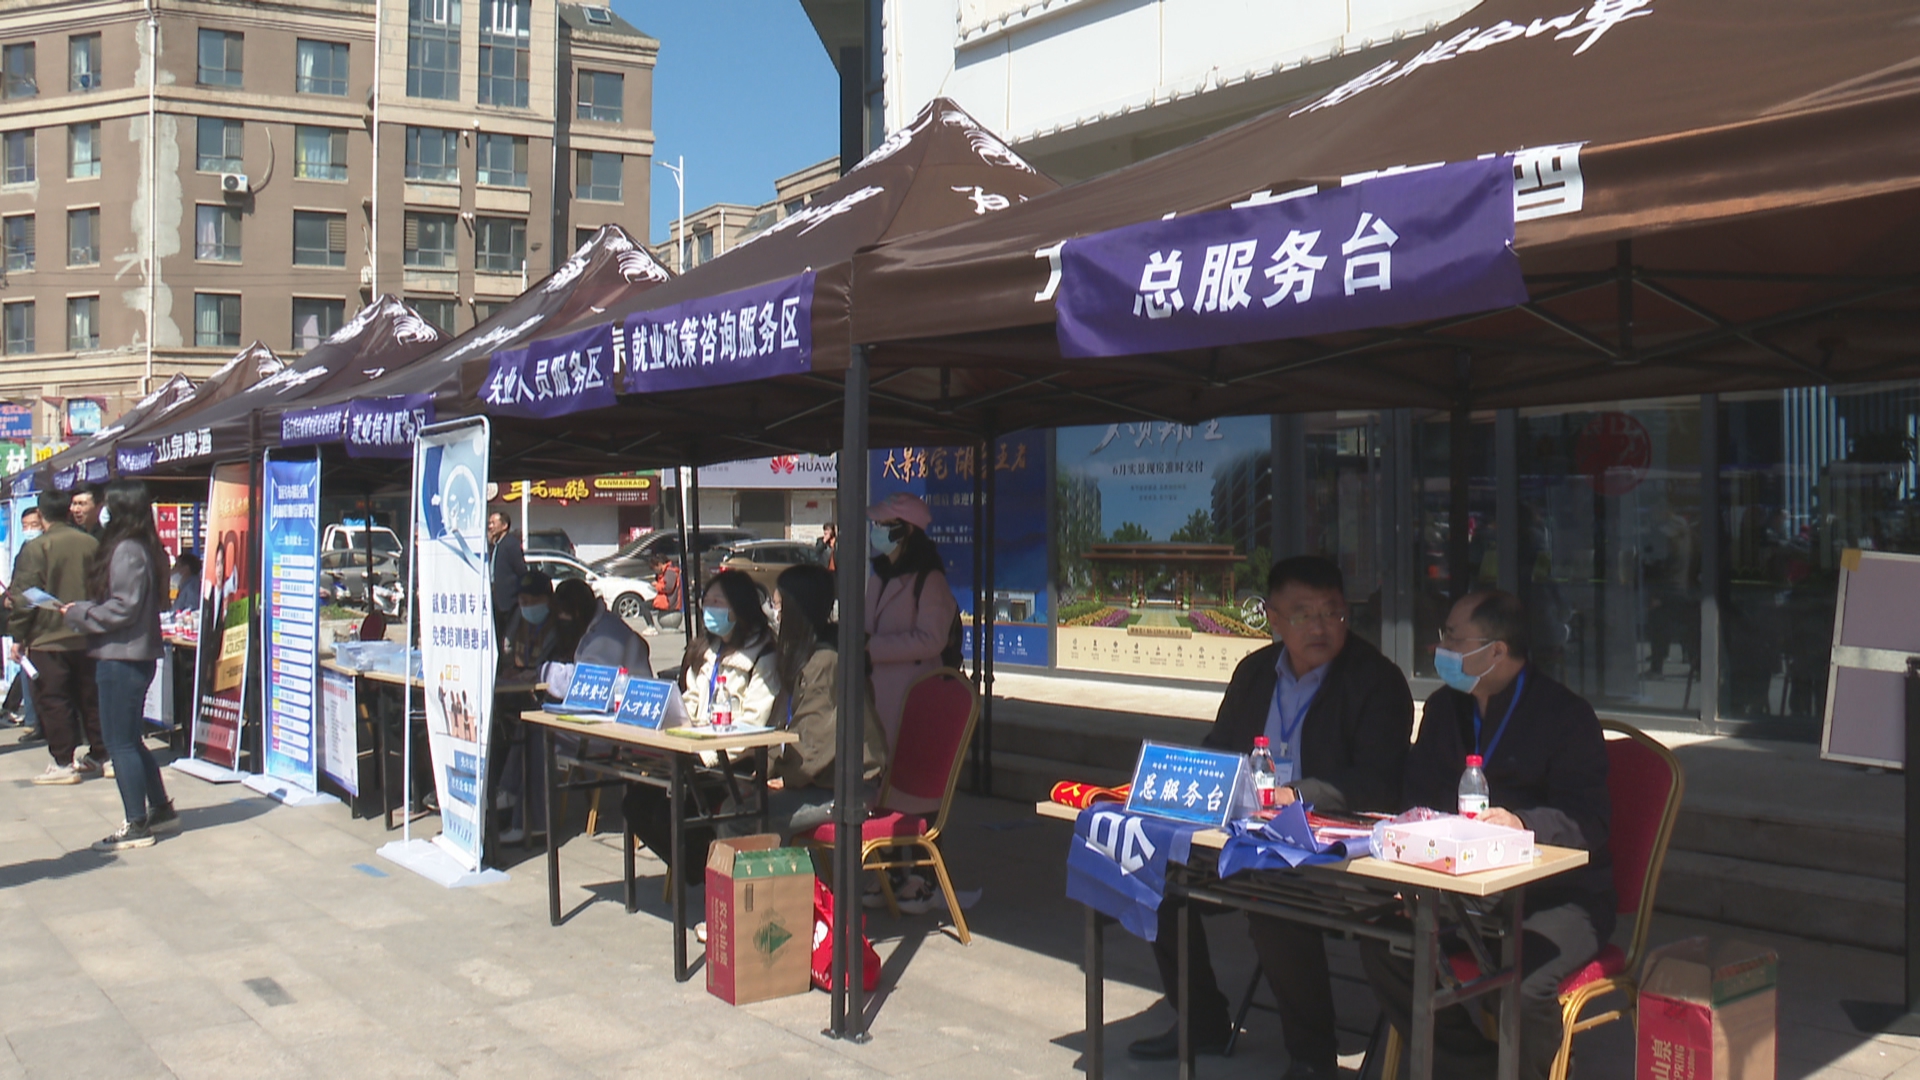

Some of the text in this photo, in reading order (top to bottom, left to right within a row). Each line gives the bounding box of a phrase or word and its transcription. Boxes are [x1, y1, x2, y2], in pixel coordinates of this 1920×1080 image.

[1133, 212, 1400, 319] 总服务台
[631, 296, 801, 373] 就业政策咨询服务区
[486, 346, 605, 405] 失业人员服务区
[150, 427, 213, 463] 山泉啤酒
[570, 679, 609, 701] 求职登记
[621, 699, 662, 721] 人才服务
[1138, 772, 1225, 813] 总服务台
